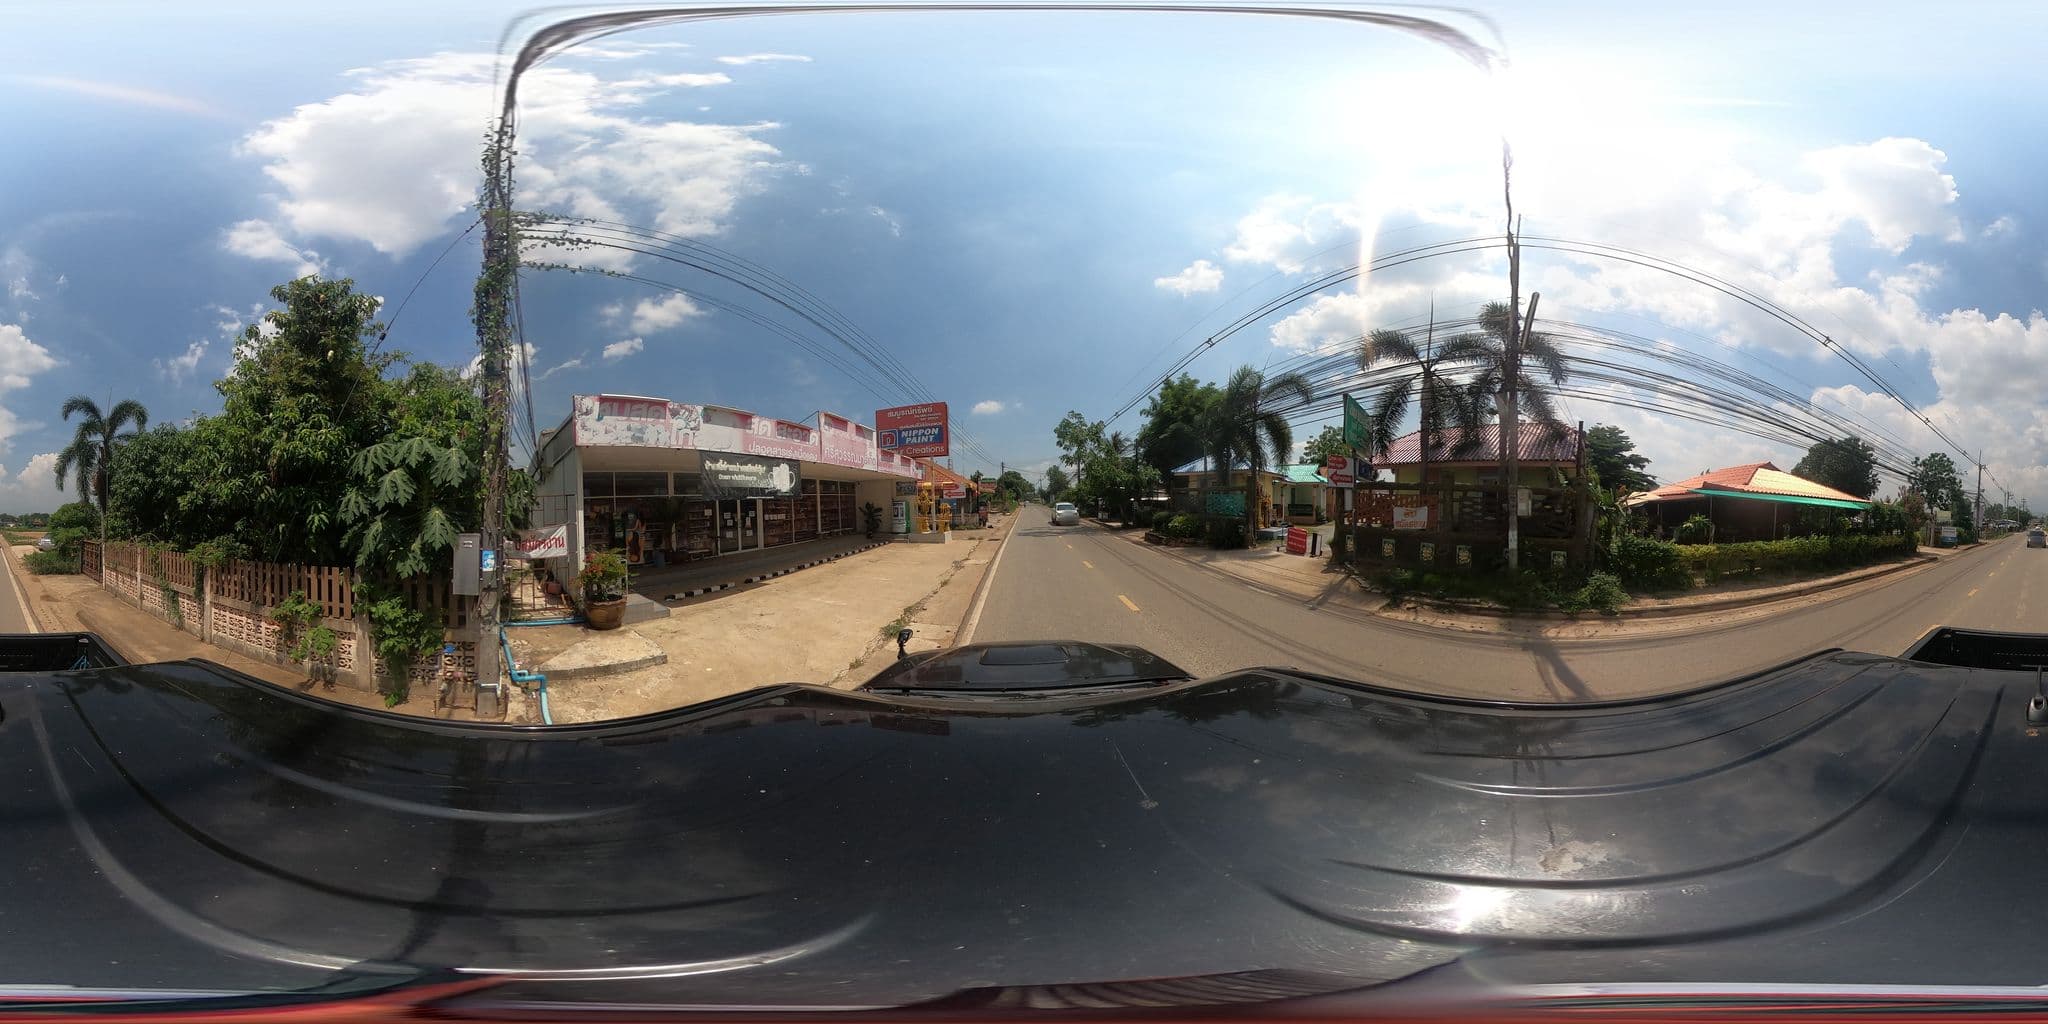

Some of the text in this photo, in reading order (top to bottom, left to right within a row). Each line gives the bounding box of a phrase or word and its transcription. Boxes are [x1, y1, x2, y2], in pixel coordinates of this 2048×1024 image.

[901, 428, 939, 438] NIPPON
[905, 436, 935, 444] PAINT
[906, 446, 945, 455] Creations
